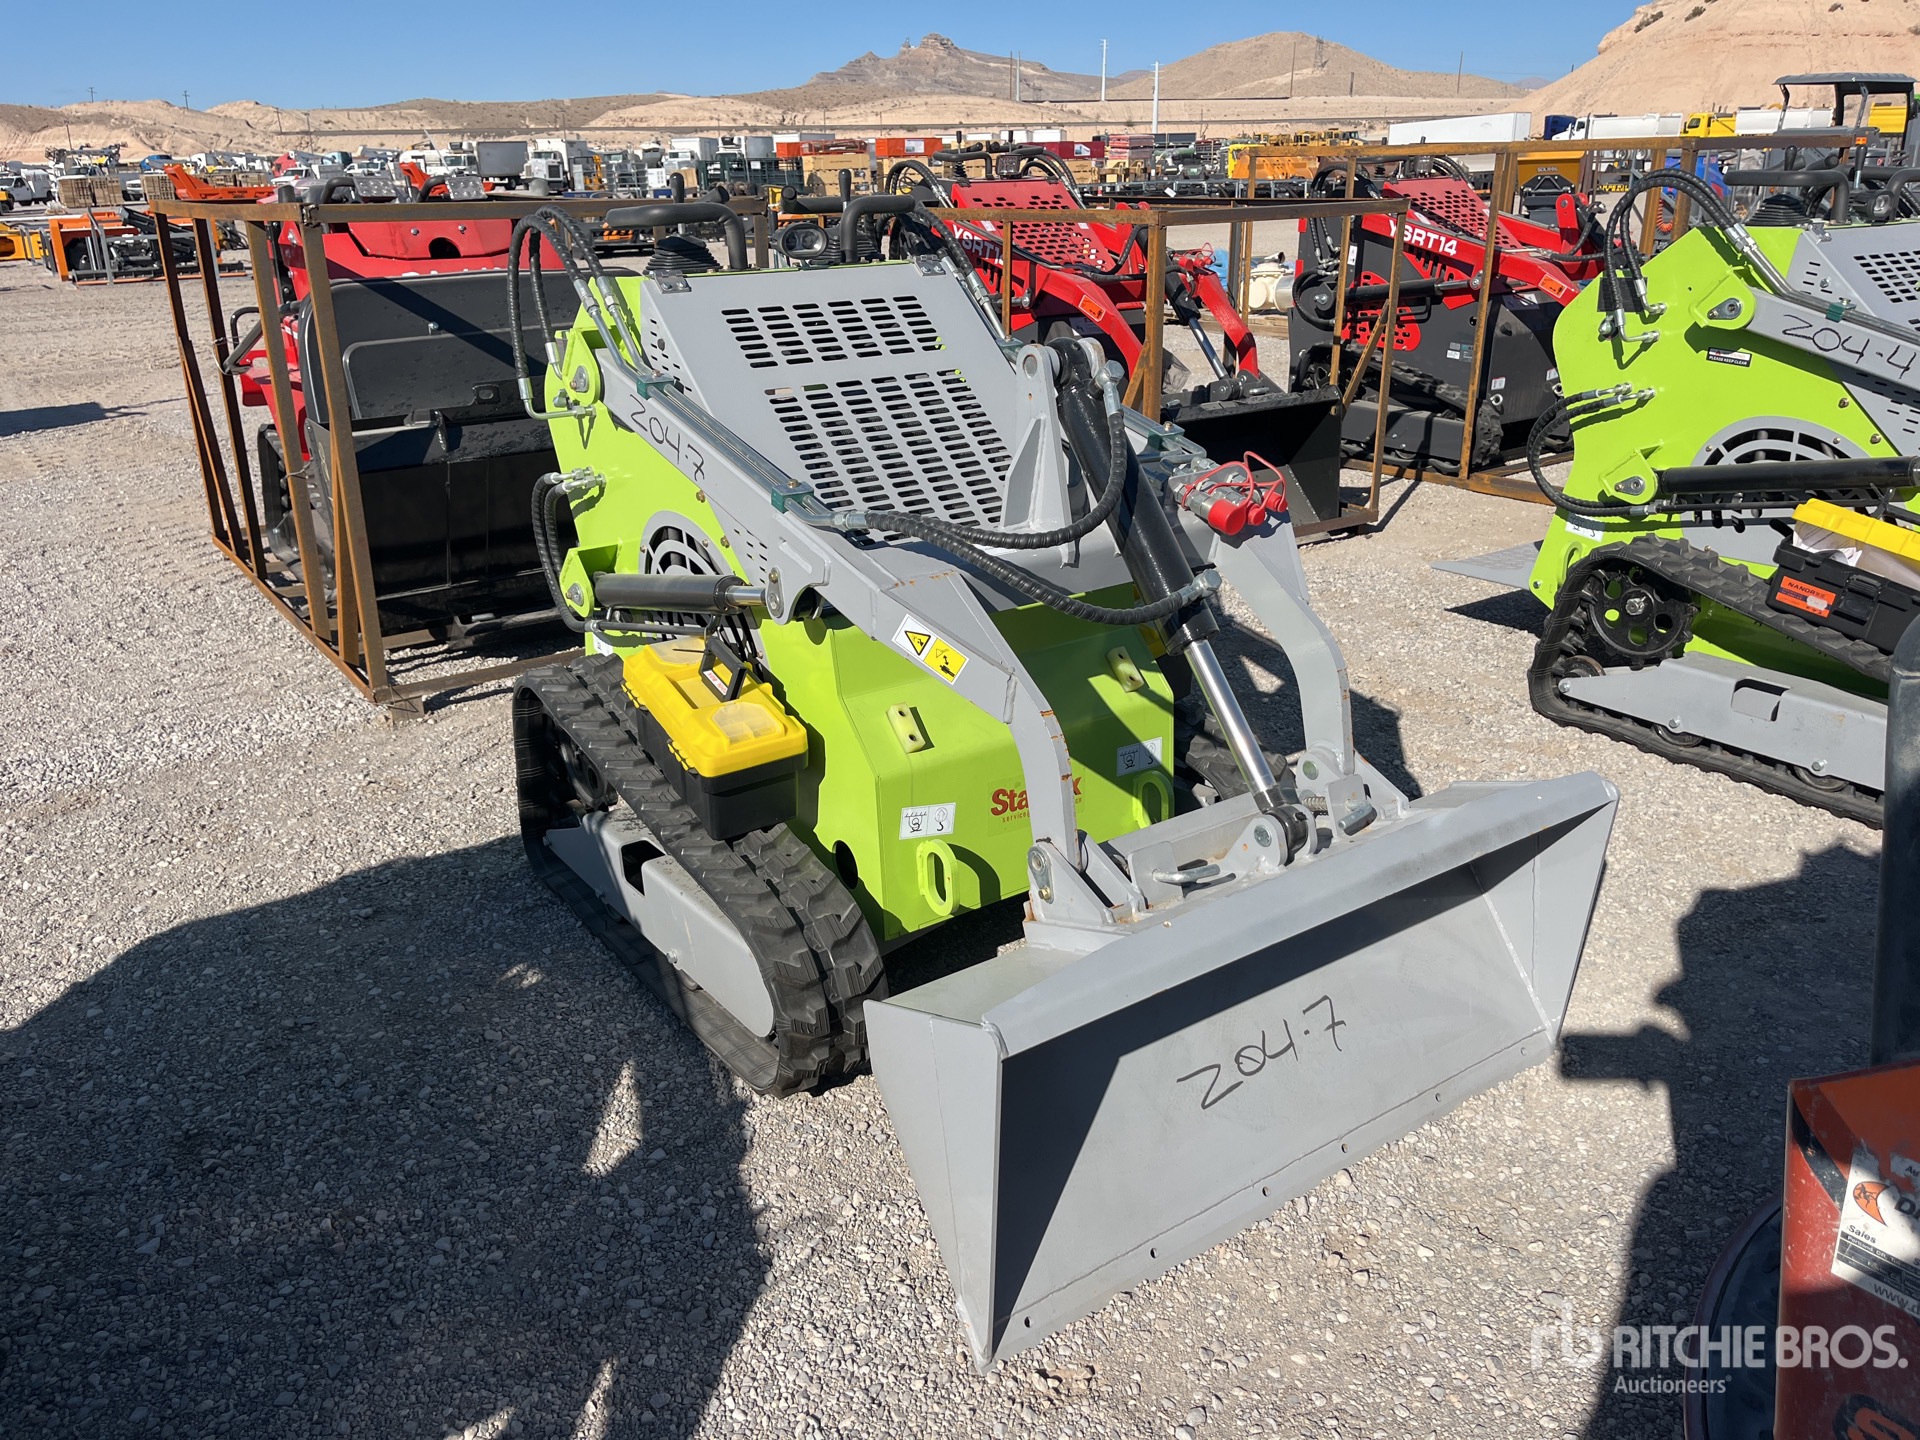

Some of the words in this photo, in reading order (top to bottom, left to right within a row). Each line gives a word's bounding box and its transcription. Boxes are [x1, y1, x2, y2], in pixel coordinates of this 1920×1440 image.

[1389, 219, 1458, 256] YSRT14
[1781, 314, 1917, 380] 204-4
[1848, 1224, 1877, 1244] Sales
